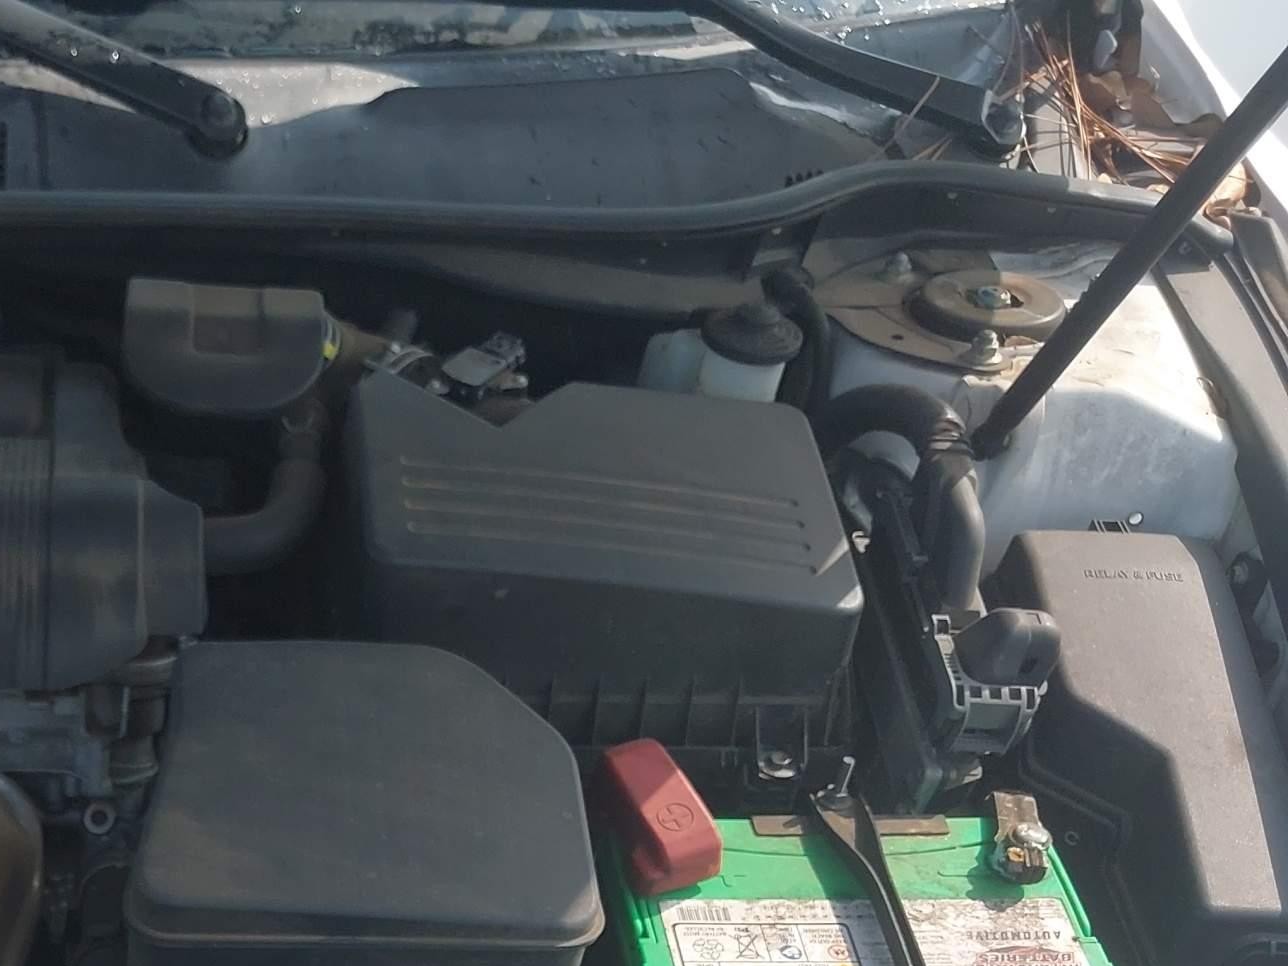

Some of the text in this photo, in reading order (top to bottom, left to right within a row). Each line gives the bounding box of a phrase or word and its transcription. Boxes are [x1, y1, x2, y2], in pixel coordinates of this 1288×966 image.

[1083, 568, 1185, 583] RELAY & FUSE
[965, 930, 1061, 941] AUTOMOTIVE
[978, 953, 1073, 963] BATTERIES
